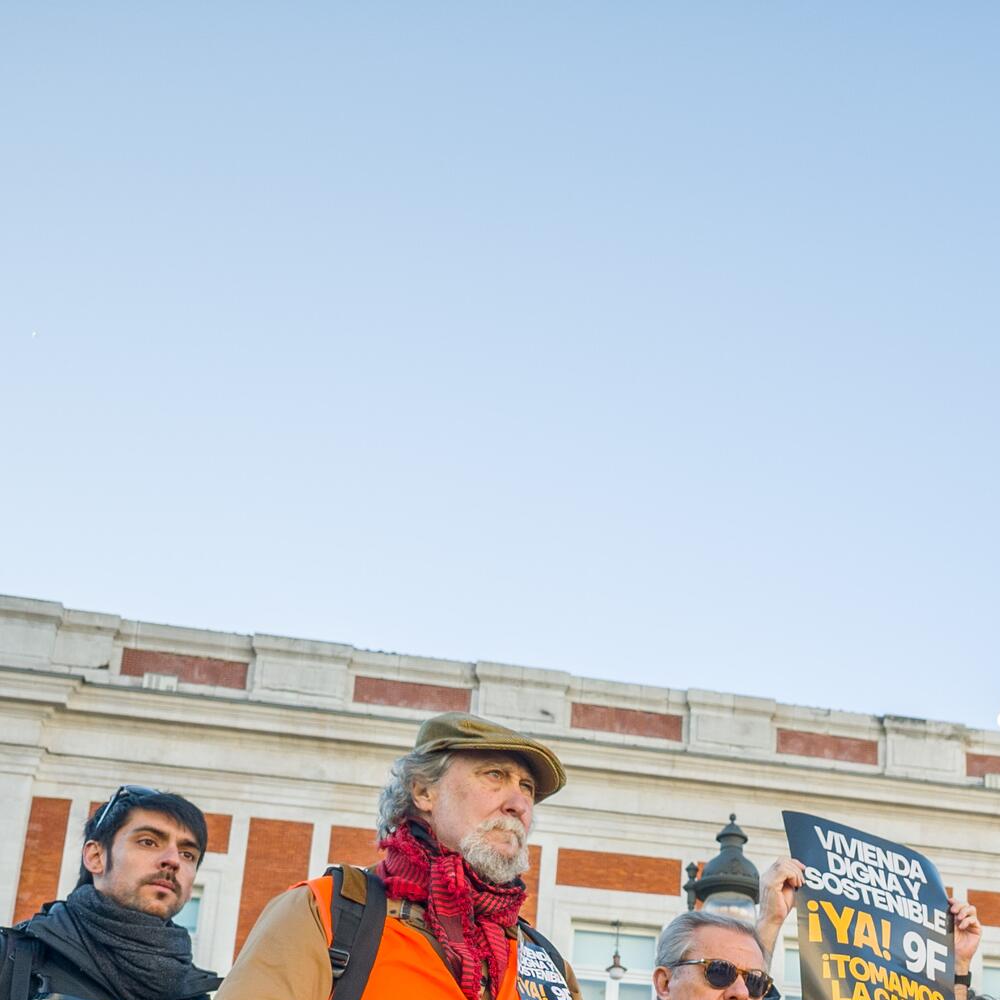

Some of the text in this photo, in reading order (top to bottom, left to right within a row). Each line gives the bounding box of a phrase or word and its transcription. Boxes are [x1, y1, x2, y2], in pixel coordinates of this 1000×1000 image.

[814, 826, 928, 884] VIVIENDA
[827, 852, 921, 900] DIGNA Y
[804, 867, 946, 936] SOSTENIBLE
[806, 900, 948, 981] ¡YA! 9F
